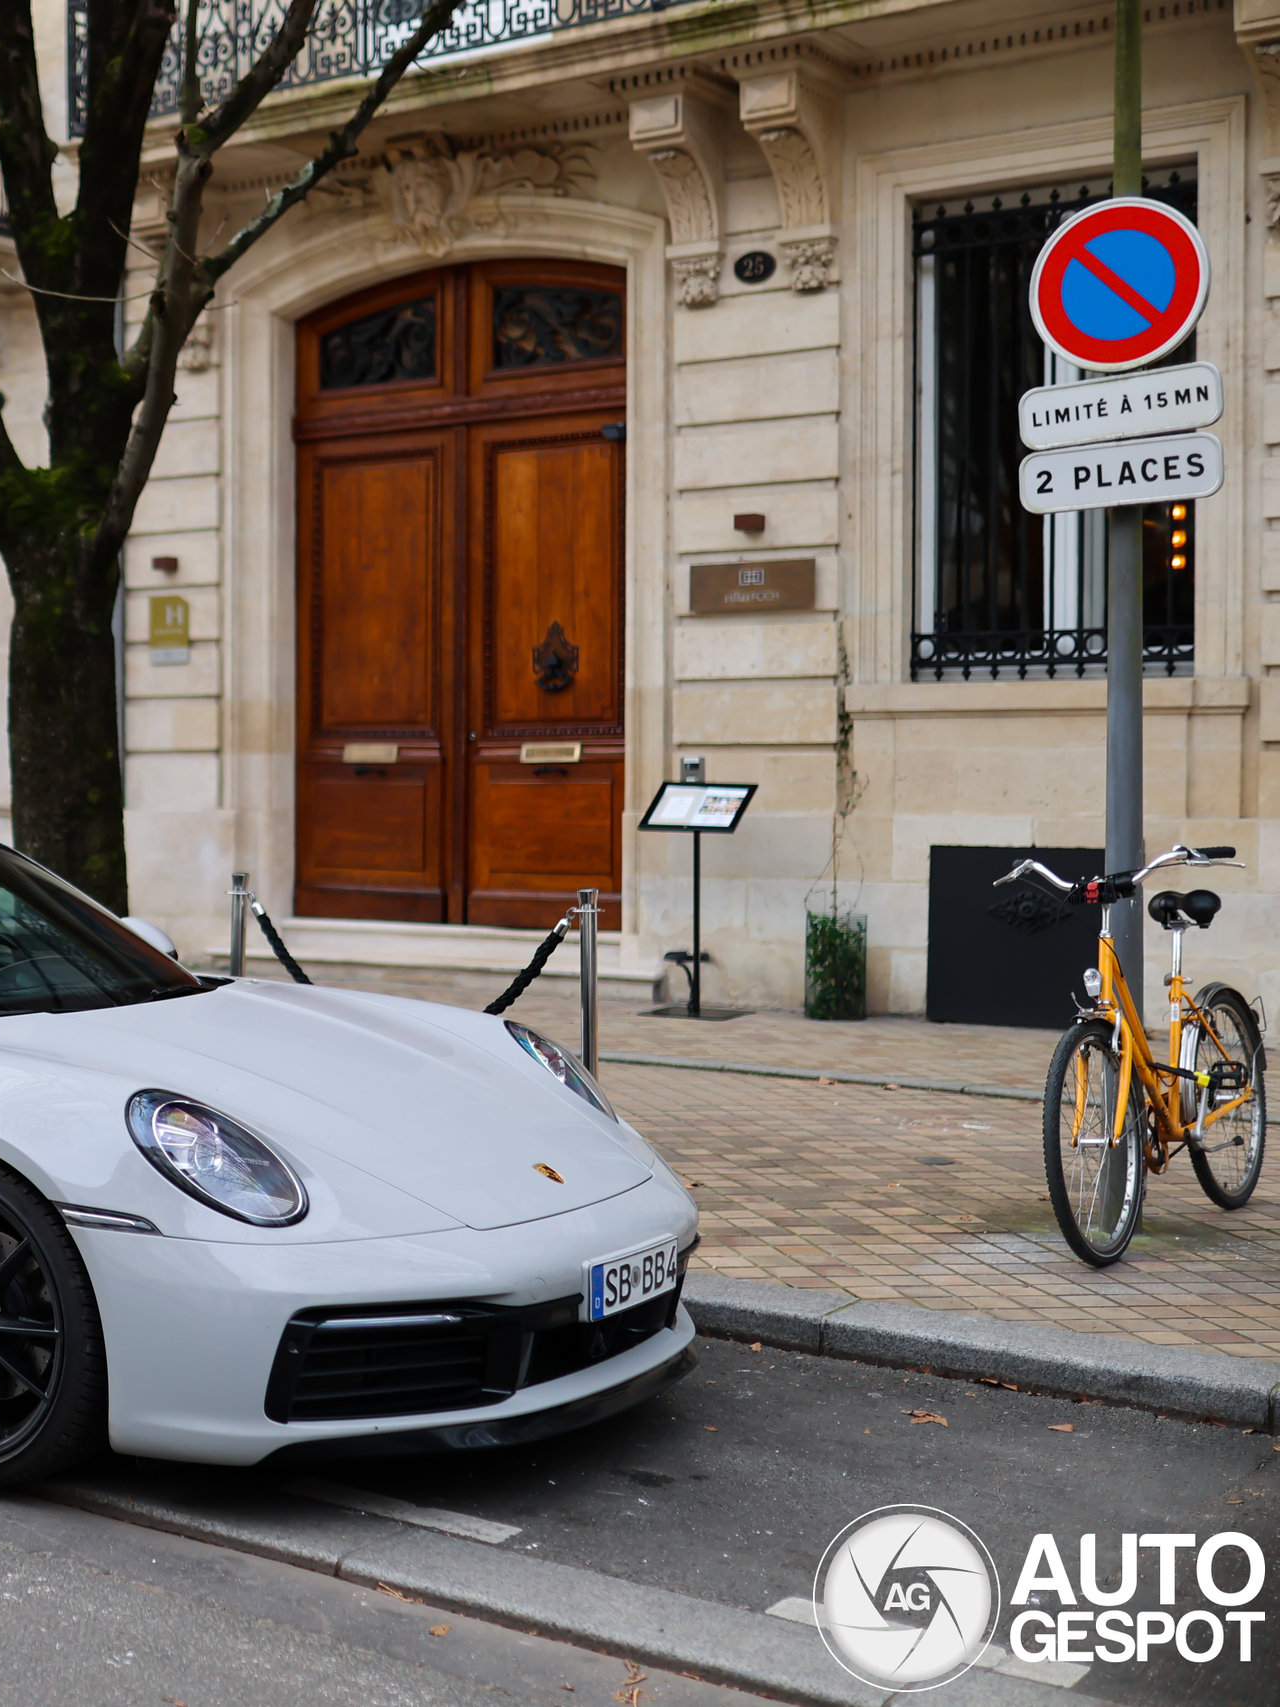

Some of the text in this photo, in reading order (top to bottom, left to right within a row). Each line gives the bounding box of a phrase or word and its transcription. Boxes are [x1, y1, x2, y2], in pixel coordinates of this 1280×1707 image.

[743, 256, 765, 277] 25
[1032, 398, 1108, 428] LIMITÉ
[1121, 393, 1133, 414] À
[1036, 453, 1205, 494] 2 PLACES
[166, 605, 184, 626] H
[595, 1297, 601, 1309] D
